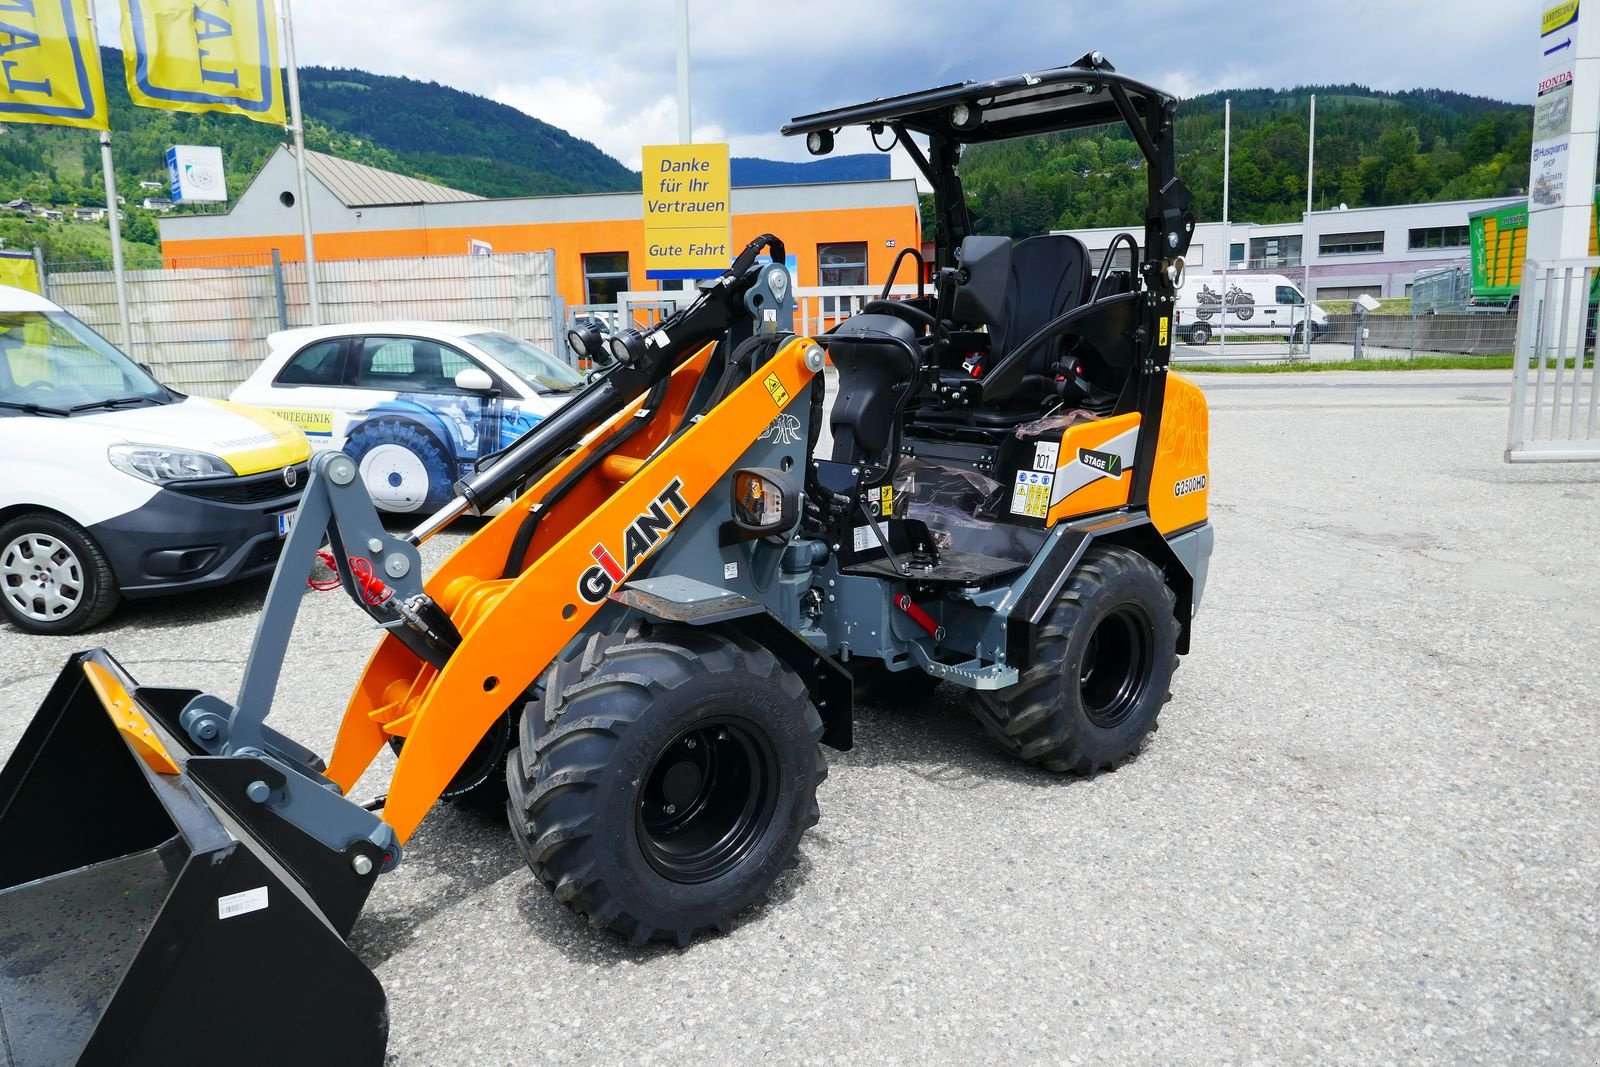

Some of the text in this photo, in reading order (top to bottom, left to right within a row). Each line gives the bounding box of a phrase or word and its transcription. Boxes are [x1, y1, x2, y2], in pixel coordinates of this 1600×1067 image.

[1538, 71, 1572, 91] HONDA
[661, 158, 710, 172] Danke
[660, 178, 709, 192] für Ihr
[648, 200, 725, 213] Vertrauen
[649, 243, 725, 256] Gute Fahrt
[1036, 454, 1049, 469] 101
[1084, 454, 1119, 471] STAGE V
[1175, 475, 1206, 496] G2500HD
